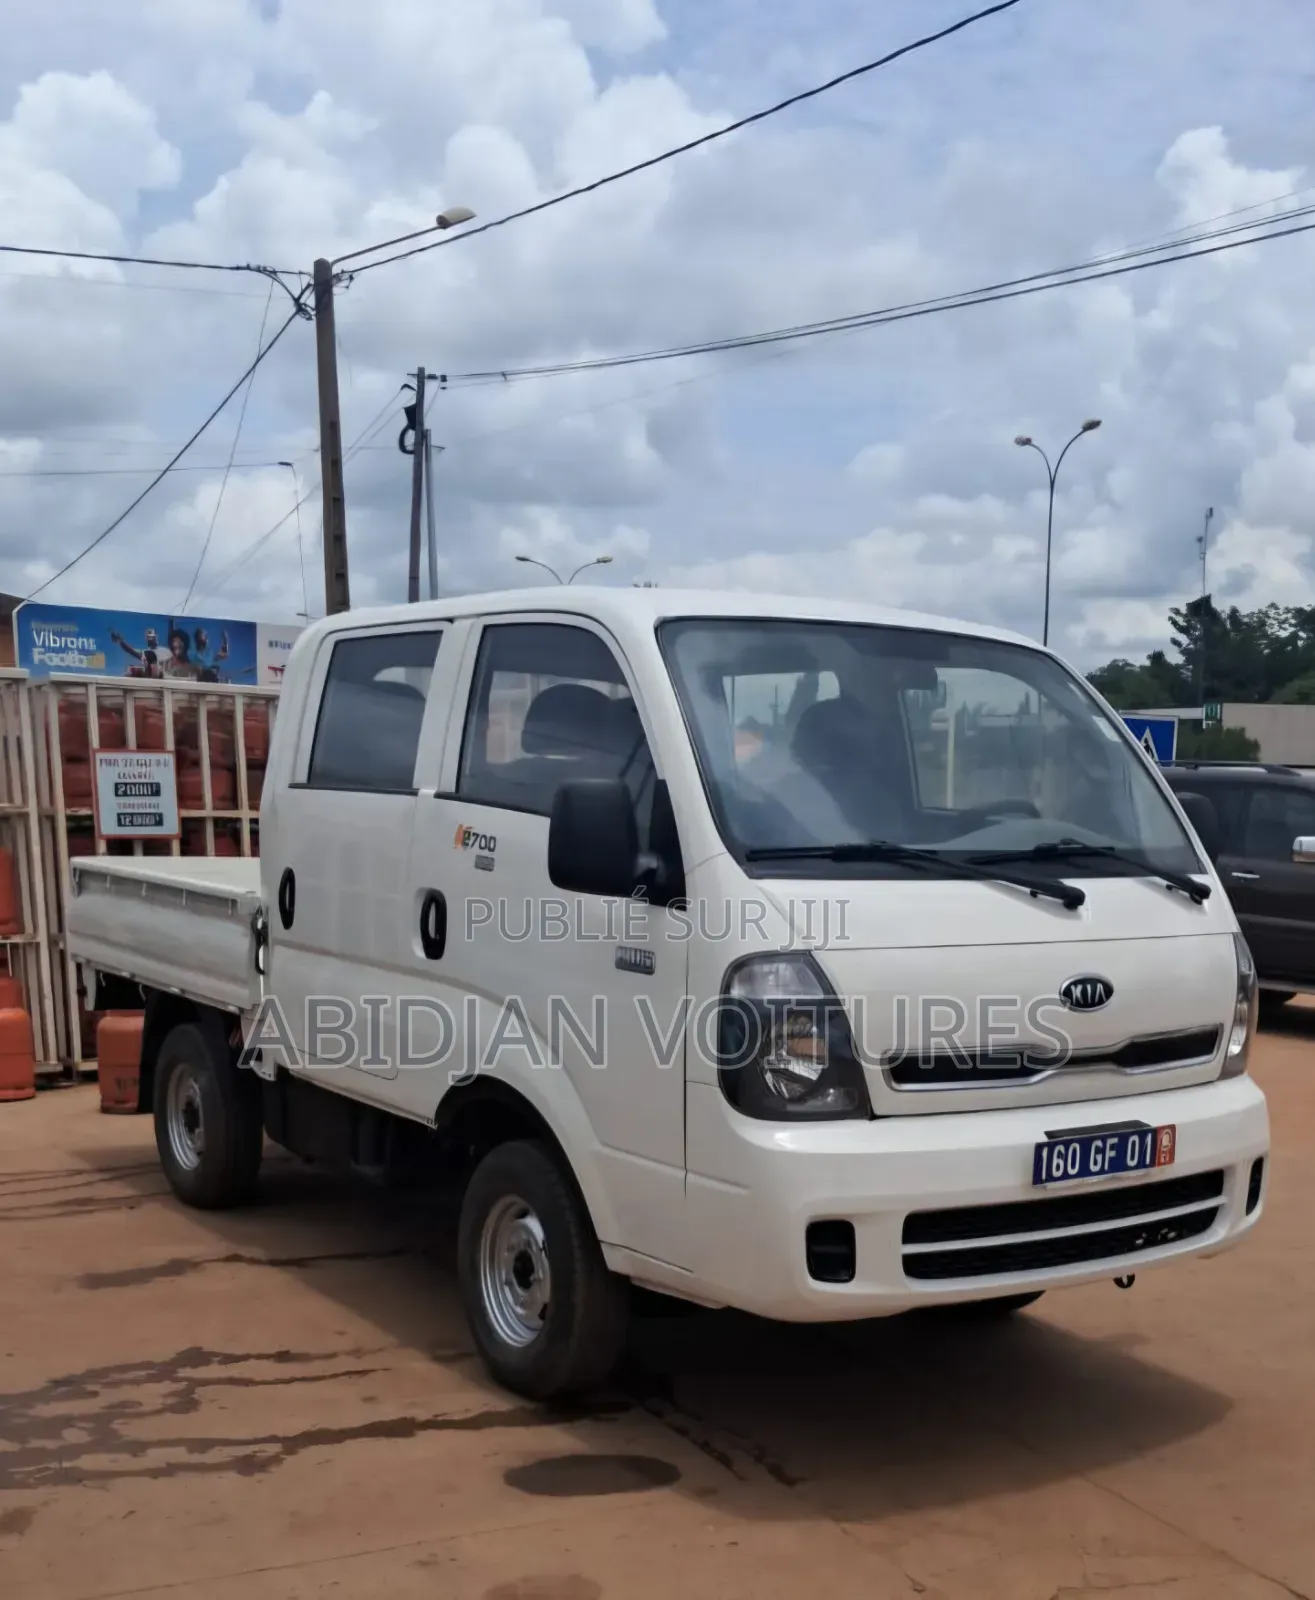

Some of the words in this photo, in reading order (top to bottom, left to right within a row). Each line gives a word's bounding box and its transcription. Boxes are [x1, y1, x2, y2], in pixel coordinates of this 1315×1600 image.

[1070, 982, 1107, 1005] KIA
[1041, 1142, 1080, 1180] 160
[1089, 1137, 1119, 1173] GF
[1126, 1132, 1152, 1168] 01
